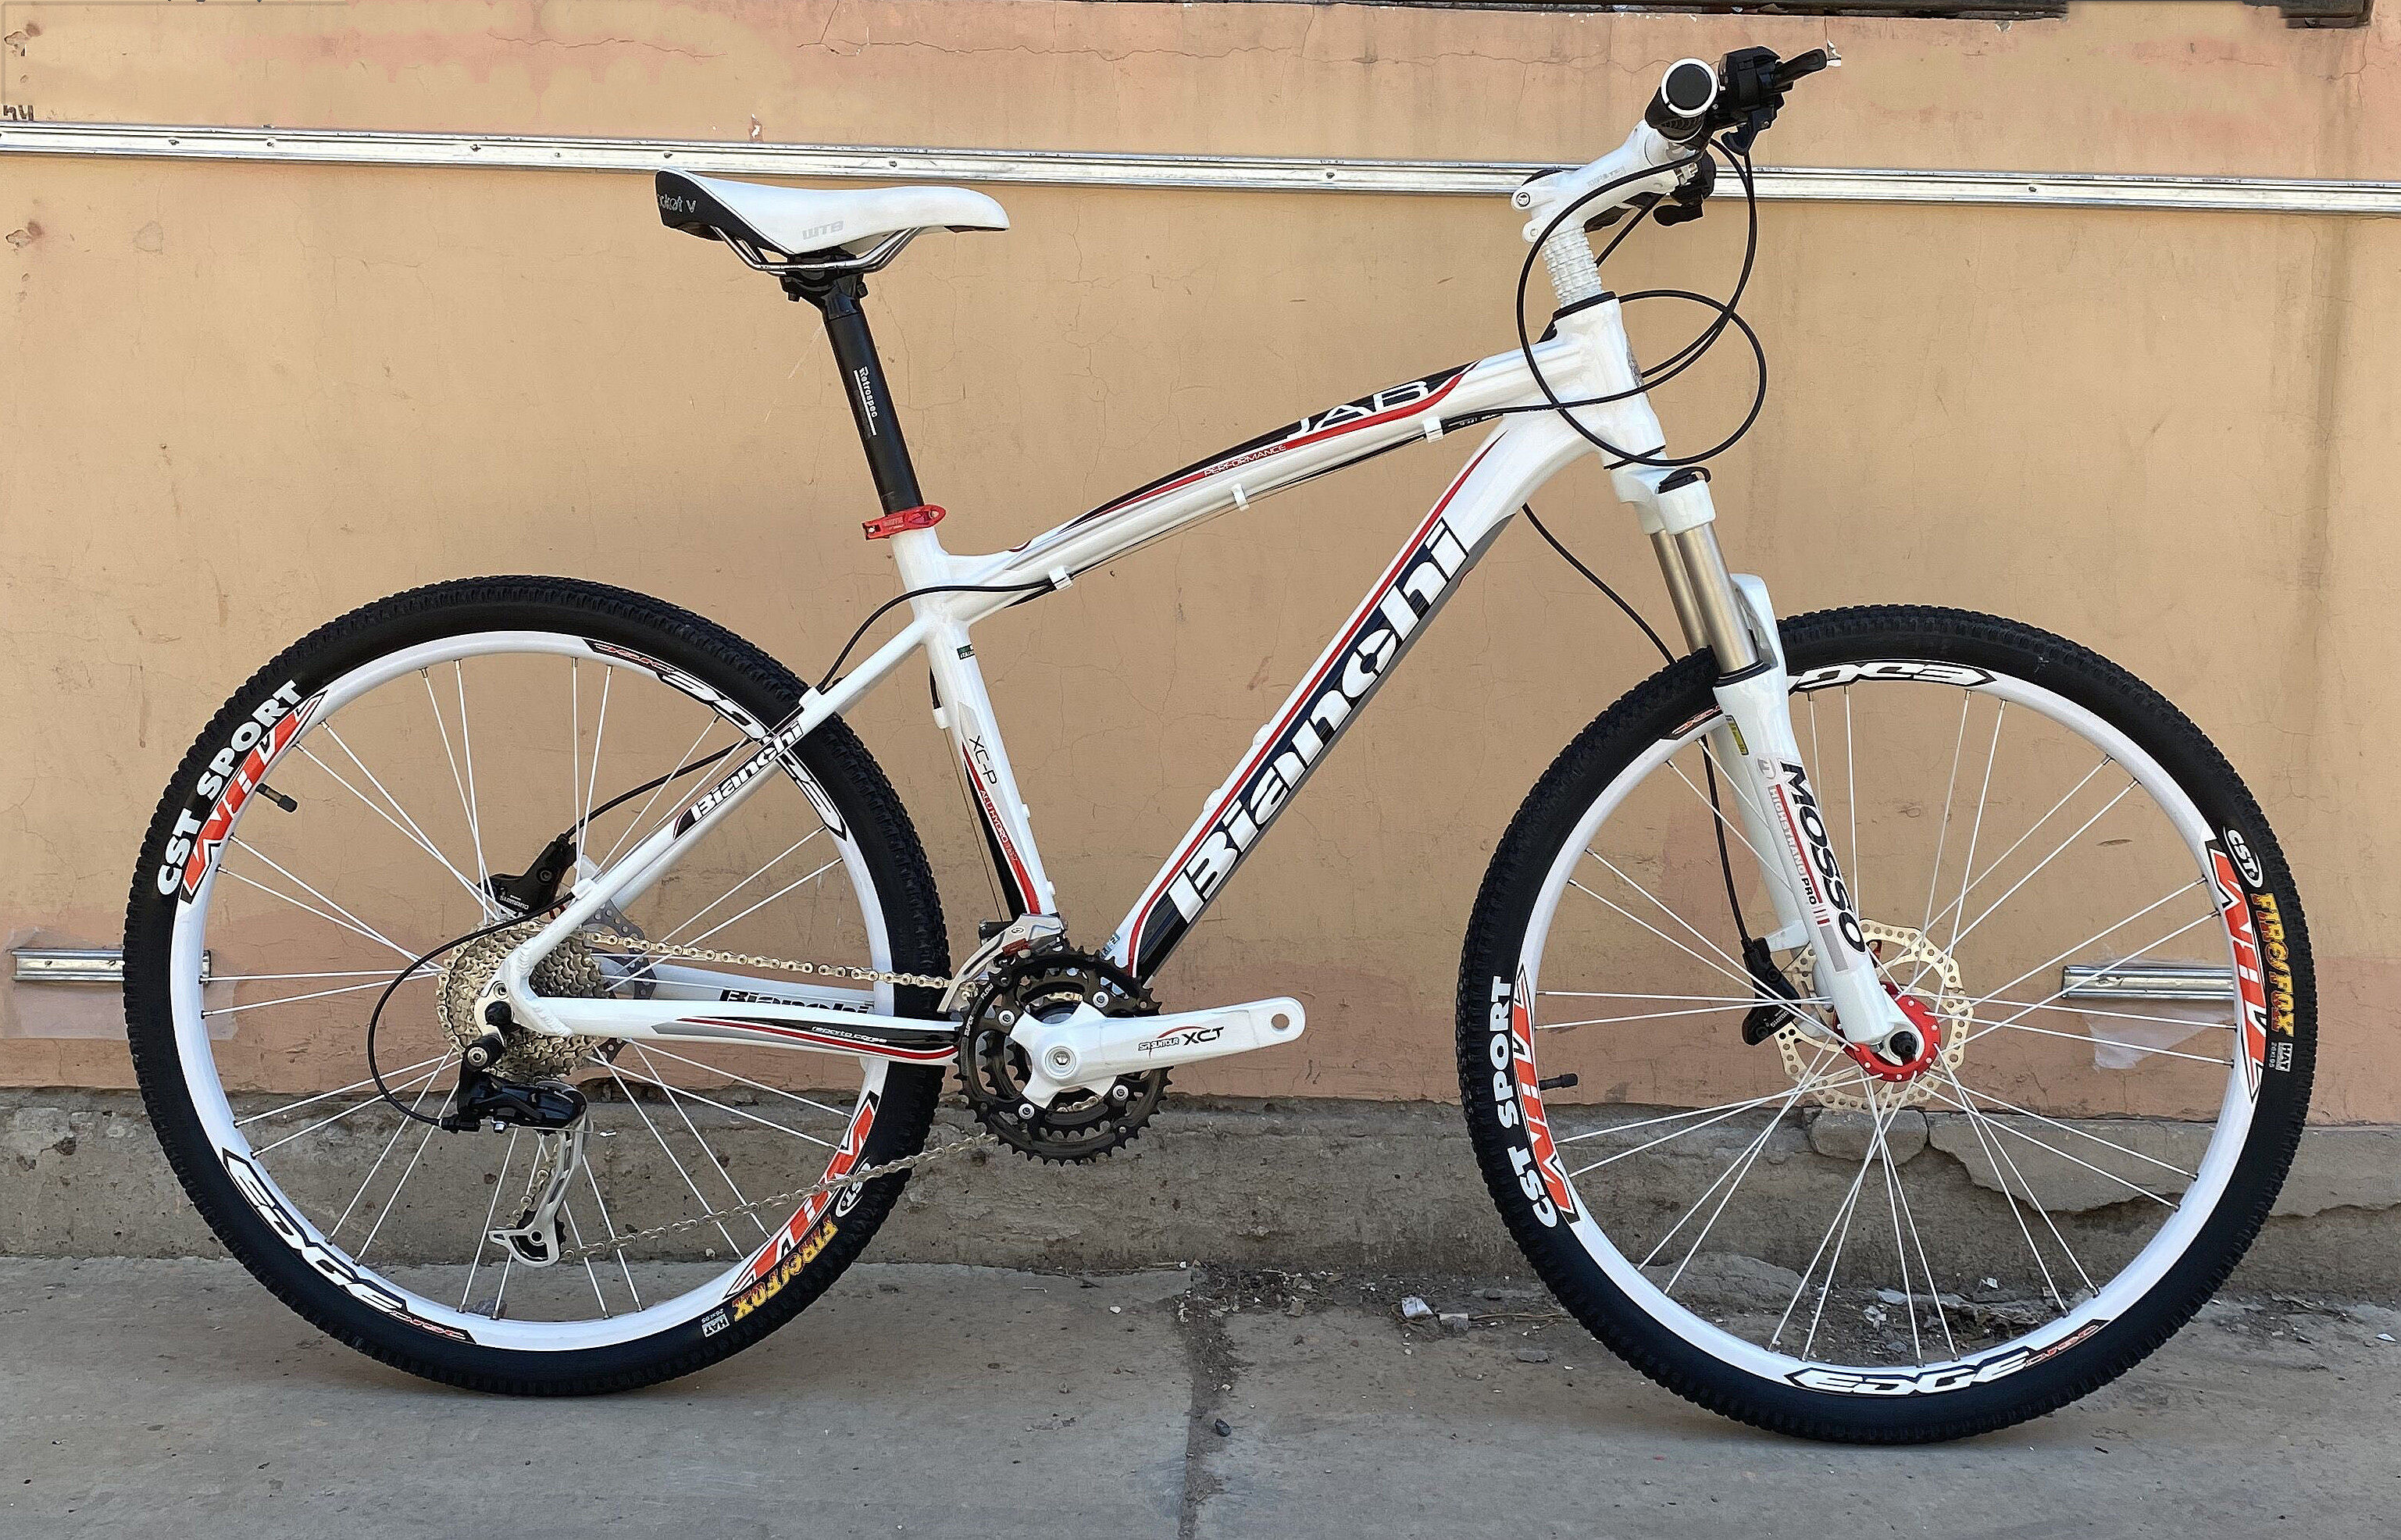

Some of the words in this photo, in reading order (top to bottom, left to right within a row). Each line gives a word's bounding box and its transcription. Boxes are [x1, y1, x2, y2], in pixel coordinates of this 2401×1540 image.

[859, 366, 879, 419] Retrospec
[1286, 380, 1429, 440] JAB
[1204, 443, 1288, 477] PERFORMANCE
[1167, 517, 1469, 925] Bianchi
[690, 719, 804, 822] Bianchi
[969, 736, 997, 785] XC-P
[157, 807, 202, 896] CST
[196, 679, 302, 800] SPORT
[1779, 758, 1867, 954] MOSSO
[2226, 829, 2259, 881] CST
[1800, 876, 1818, 906] PRO
[1183, 1026, 1225, 1046] XCT
[1489, 975, 1520, 1129] SPORT
[2281, 1044, 2291, 1070] HAT
[1507, 1145, 1558, 1228] CST
[1791, 1349, 2032, 1397] EDGE
